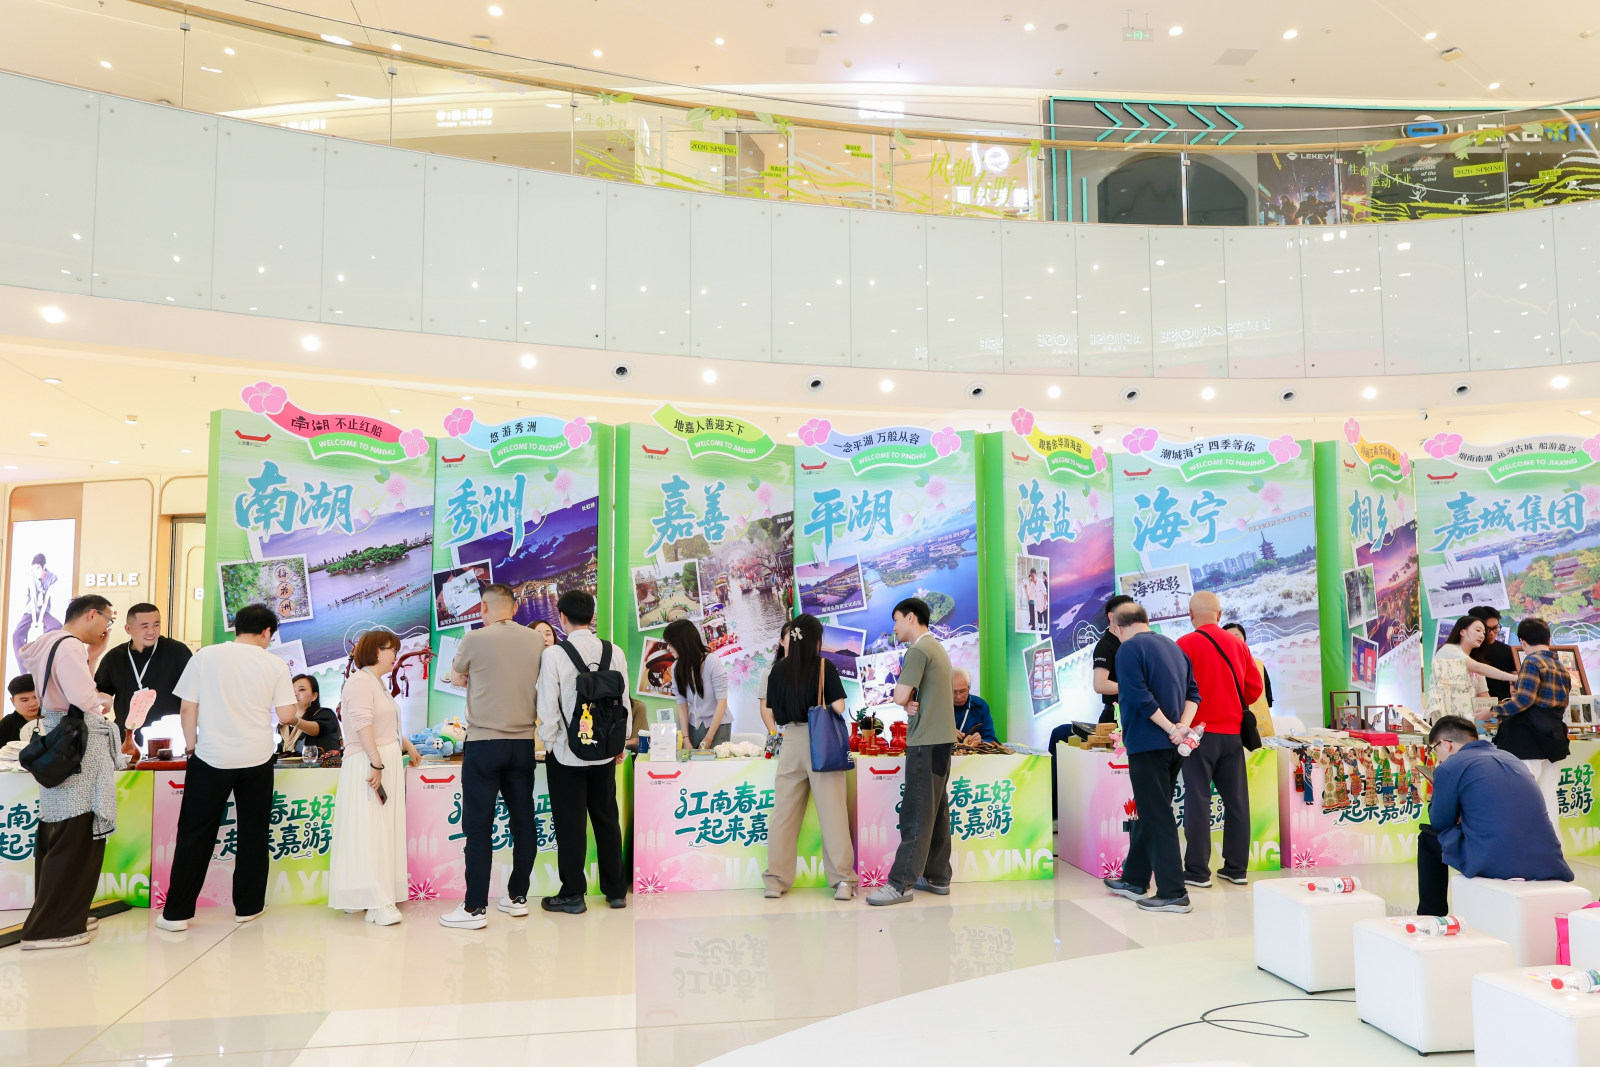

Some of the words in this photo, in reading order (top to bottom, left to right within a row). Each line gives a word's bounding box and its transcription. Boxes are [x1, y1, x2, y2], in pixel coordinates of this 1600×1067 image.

[690, 143, 708, 151] 2026
[711, 145, 738, 154] SPRING
[1475, 164, 1505, 173] SPRING
[291, 415, 330, 431] 南湖
[335, 417, 383, 438] 不止红船
[490, 421, 537, 443] 悠游秀洲
[673, 417, 745, 436] 地嘉人善迎天下
[318, 439, 358, 448] WELCOME
[359, 442, 369, 450] TO
[370, 446, 396, 456] NANHU
[496, 443, 528, 456] WELCOME
[538, 439, 567, 451] XIUZHOU
[694, 439, 724, 448] WELCOME
[833, 435, 874, 453] 一念平湖
[876, 431, 921, 445] 万般从容
[1160, 443, 1204, 460] 潮城海宁
[1208, 438, 1256, 452] 四季等你
[1496, 443, 1534, 459] 运河古城
[1538, 442, 1577, 454] 船游嘉兴
[858, 452, 890, 465] WELCOME
[901, 452, 927, 460] PINGHU
[1189, 458, 1224, 472] WELCOME
[1225, 458, 1234, 466] TO
[1235, 458, 1266, 467] HAINING
[1497, 459, 1535, 473] WELCOME
[1536, 458, 1546, 466] TO
[1547, 458, 1578, 466] JIAXING
[235, 461, 355, 540] 南湖
[1018, 479, 1076, 544] 海盐
[441, 474, 526, 555] 秀洲
[645, 475, 730, 557] 嘉善
[804, 488, 894, 562] 平湖
[1131, 487, 1227, 550] 海宁
[1349, 489, 1388, 551] 桐乡
[1426, 491, 1586, 551] 嘉城集团
[85, 573, 140, 587] BELLE
[1132, 575, 1192, 598] 海宁皮影
[950, 775, 1015, 808] 春正好
